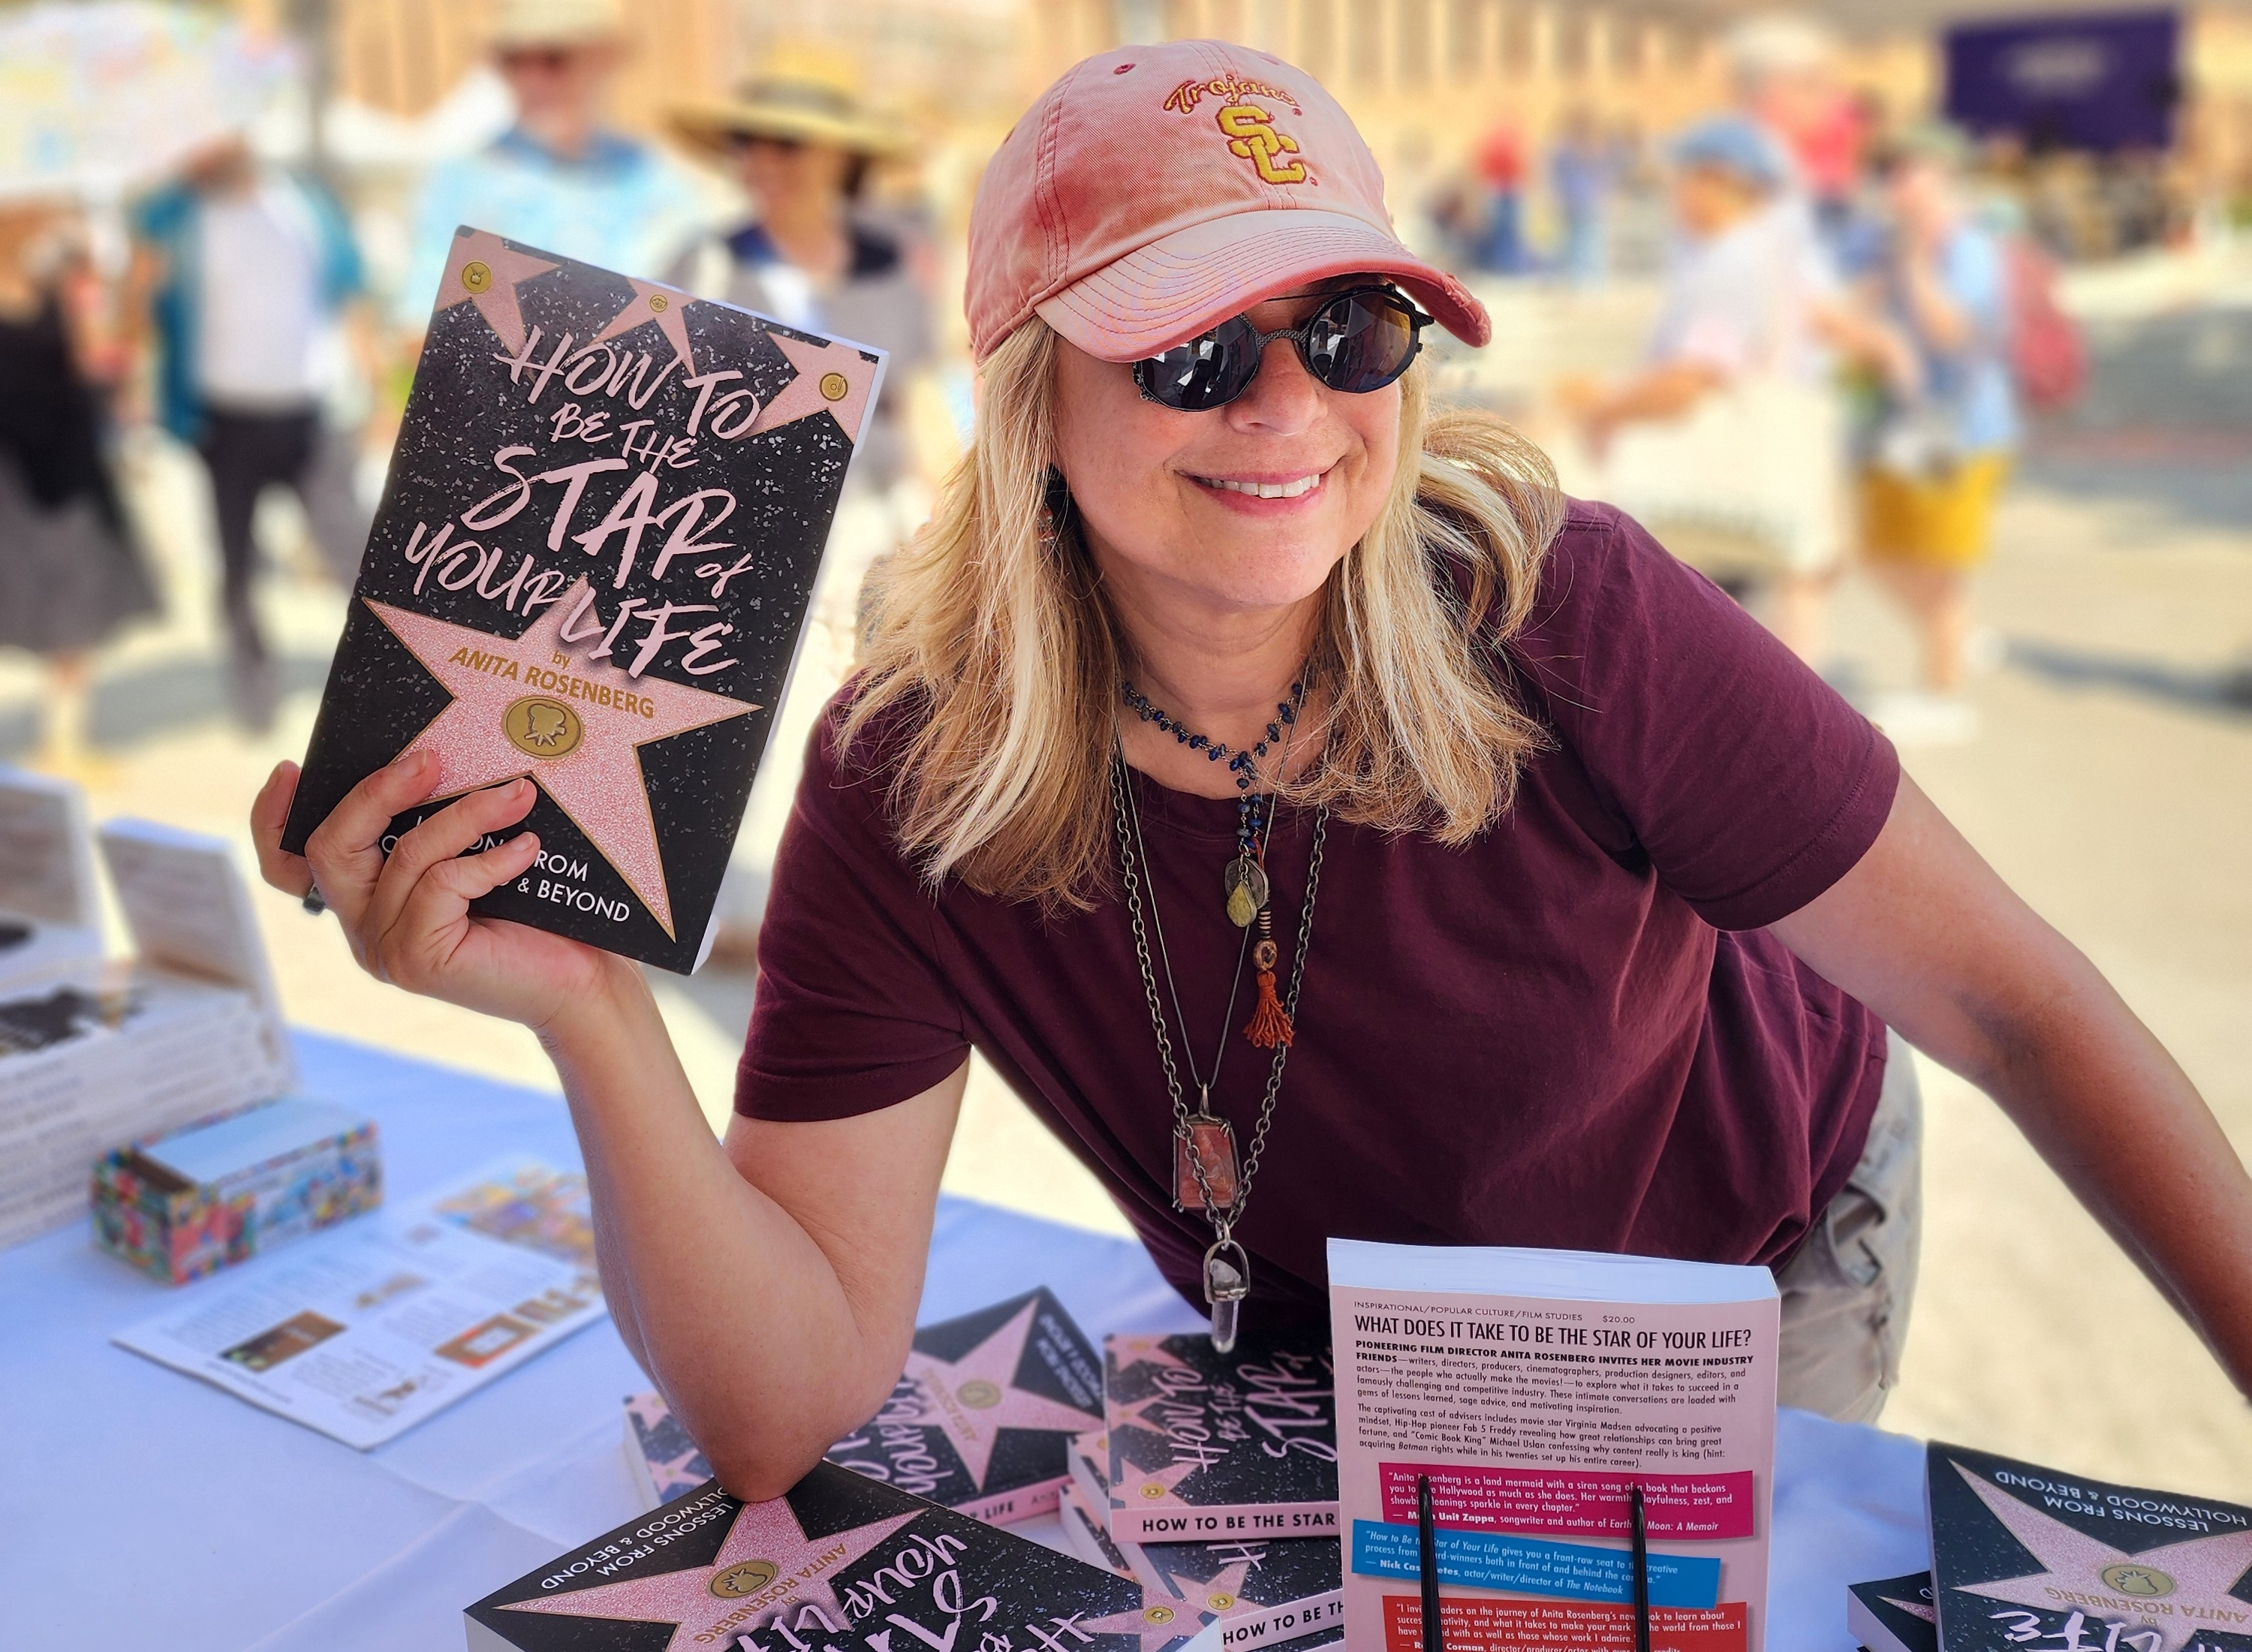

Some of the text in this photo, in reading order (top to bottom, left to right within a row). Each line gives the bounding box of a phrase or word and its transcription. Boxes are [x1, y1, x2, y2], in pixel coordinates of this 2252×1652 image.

[1164, 74, 1300, 113] Trojans
[1215, 104, 1308, 185] SC
[492, 324, 761, 440] HOW TO
[549, 402, 700, 474] BE THE
[460, 446, 754, 599] STAR of
[405, 521, 739, 679] YOUR LIFE
[552, 650, 571, 670] by
[448, 647, 654, 719] ANITA ROSENBERG
[534, 849, 589, 882] ROM
[517, 877, 630, 922] & BEYOND
[1354, 1301, 1635, 1324] INSPIRATIONAL/POPULAR CULTURE/FILM STUDIES $20.00
[1354, 1314, 1751, 1349] WHAT DOES IT TAKE TO BE THE STAR OF YOUR LIFE?
[1356, 1340, 1754, 1367] PIONEERING FILM DIRECTOR ANITA ROSENBERG INVITES HER MOVIE INDUSTRY
[1441, 1357, 1745, 1381] directors, producers, cinematographers, production designers, editors, and
[1357, 1374, 1393, 1388] famously
[1395, 1378, 1441, 1392] challenging
[1444, 1383, 1459, 1392] and
[1463, 1386, 1508, 1395] competitive
[1512, 1387, 1546, 1399] industry.
[1551, 1389, 1572, 1399] These
[1575, 1391, 1609, 1401] intimate
[1612, 1395, 1668, 1404] conversations
[1687, 1395, 1715, 1404] loaded
[1718, 1394, 1736, 1403] with
[1381, 1389, 1389, 1398] of
[1392, 1389, 1420, 1401] lessons
[1423, 1392, 1456, 1404] learned,
[1459, 1397, 1477, 1406] sage
[1480, 1397, 1508, 1408] advice,
[1511, 1400, 1527, 1408] and
[1530, 1401, 1573, 1413] motivating
[1576, 1404, 1621, 1414] inspiration.
[1152, 1368, 1230, 1474] HOW TO
[1237, 1364, 1338, 1463] STAR
[1358, 1403, 1371, 1413] The
[1374, 1406, 1417, 1418] captivating
[1438, 1410, 1446, 1418] of
[1449, 1410, 1482, 1421] advisers
[1485, 1413, 1516, 1424] includes
[1520, 1417, 1544, 1425] movie
[1565, 1419, 1597, 1430] Virginia
[1600, 1421, 1631, 1431] Madsen
[1635, 1422, 1678, 1435] advocating
[1691, 1425, 1721, 1435] positive
[1359, 1416, 1391, 1427] mindset,
[1395, 1418, 1426, 1430] Hip-Hop
[1430, 1422, 1460, 1431] pioneer
[1463, 1423, 1477, 1432] Fab
[1480, 1425, 1486, 1433] 5
[1489, 1425, 1516, 1437] Freddy
[1519, 1428, 1556, 1440] revealing
[1559, 1429, 1576, 1439] how
[1579, 1434, 1600, 1442] great
[1603, 1433, 1655, 1446] relationships
[1675, 1436, 1697, 1448] bring
[1700, 1437, 1721, 1447] great
[985, 1501, 1013, 1519] LIFE
[1995, 1471, 2247, 1527] HOLLYWOOD & BEYOND
[2043, 1495, 2209, 1533] LESSONS FROM
[1143, 1512, 1336, 1532] HOW TO BE THE STAR
[1438, 1512, 1606, 1527] Unit Zappa, songwriter and author of
[1647, 1521, 1718, 1530] Moon: A Memoir
[540, 1485, 729, 1590] OLLYWOOD & BEYOND
[596, 1503, 733, 1576] LESSONS FROM
[843, 1533, 968, 1619] YOUR
[1380, 1559, 1404, 1569] Nick
[1464, 1569, 1623, 1594] actor/writer/director of The Notebook
[692, 1542, 847, 1644] ANITA ROSENBERG
[781, 1594, 802, 1606] by
[2044, 1587, 2250, 1623] ANITA ROSENBERG
[1223, 1621, 1266, 1646] HOW
[1273, 1616, 1295, 1632] TO
[1302, 1608, 1322, 1623] BE
[1480, 1605, 1492, 1615] the
[1495, 1607, 1527, 1619] journey
[1530, 1608, 1538, 1617] of
[1542, 1608, 1563, 1618] Anita
[1566, 1610, 1616, 1622] Rosenberg's
[2140, 1614, 2158, 1626] by
